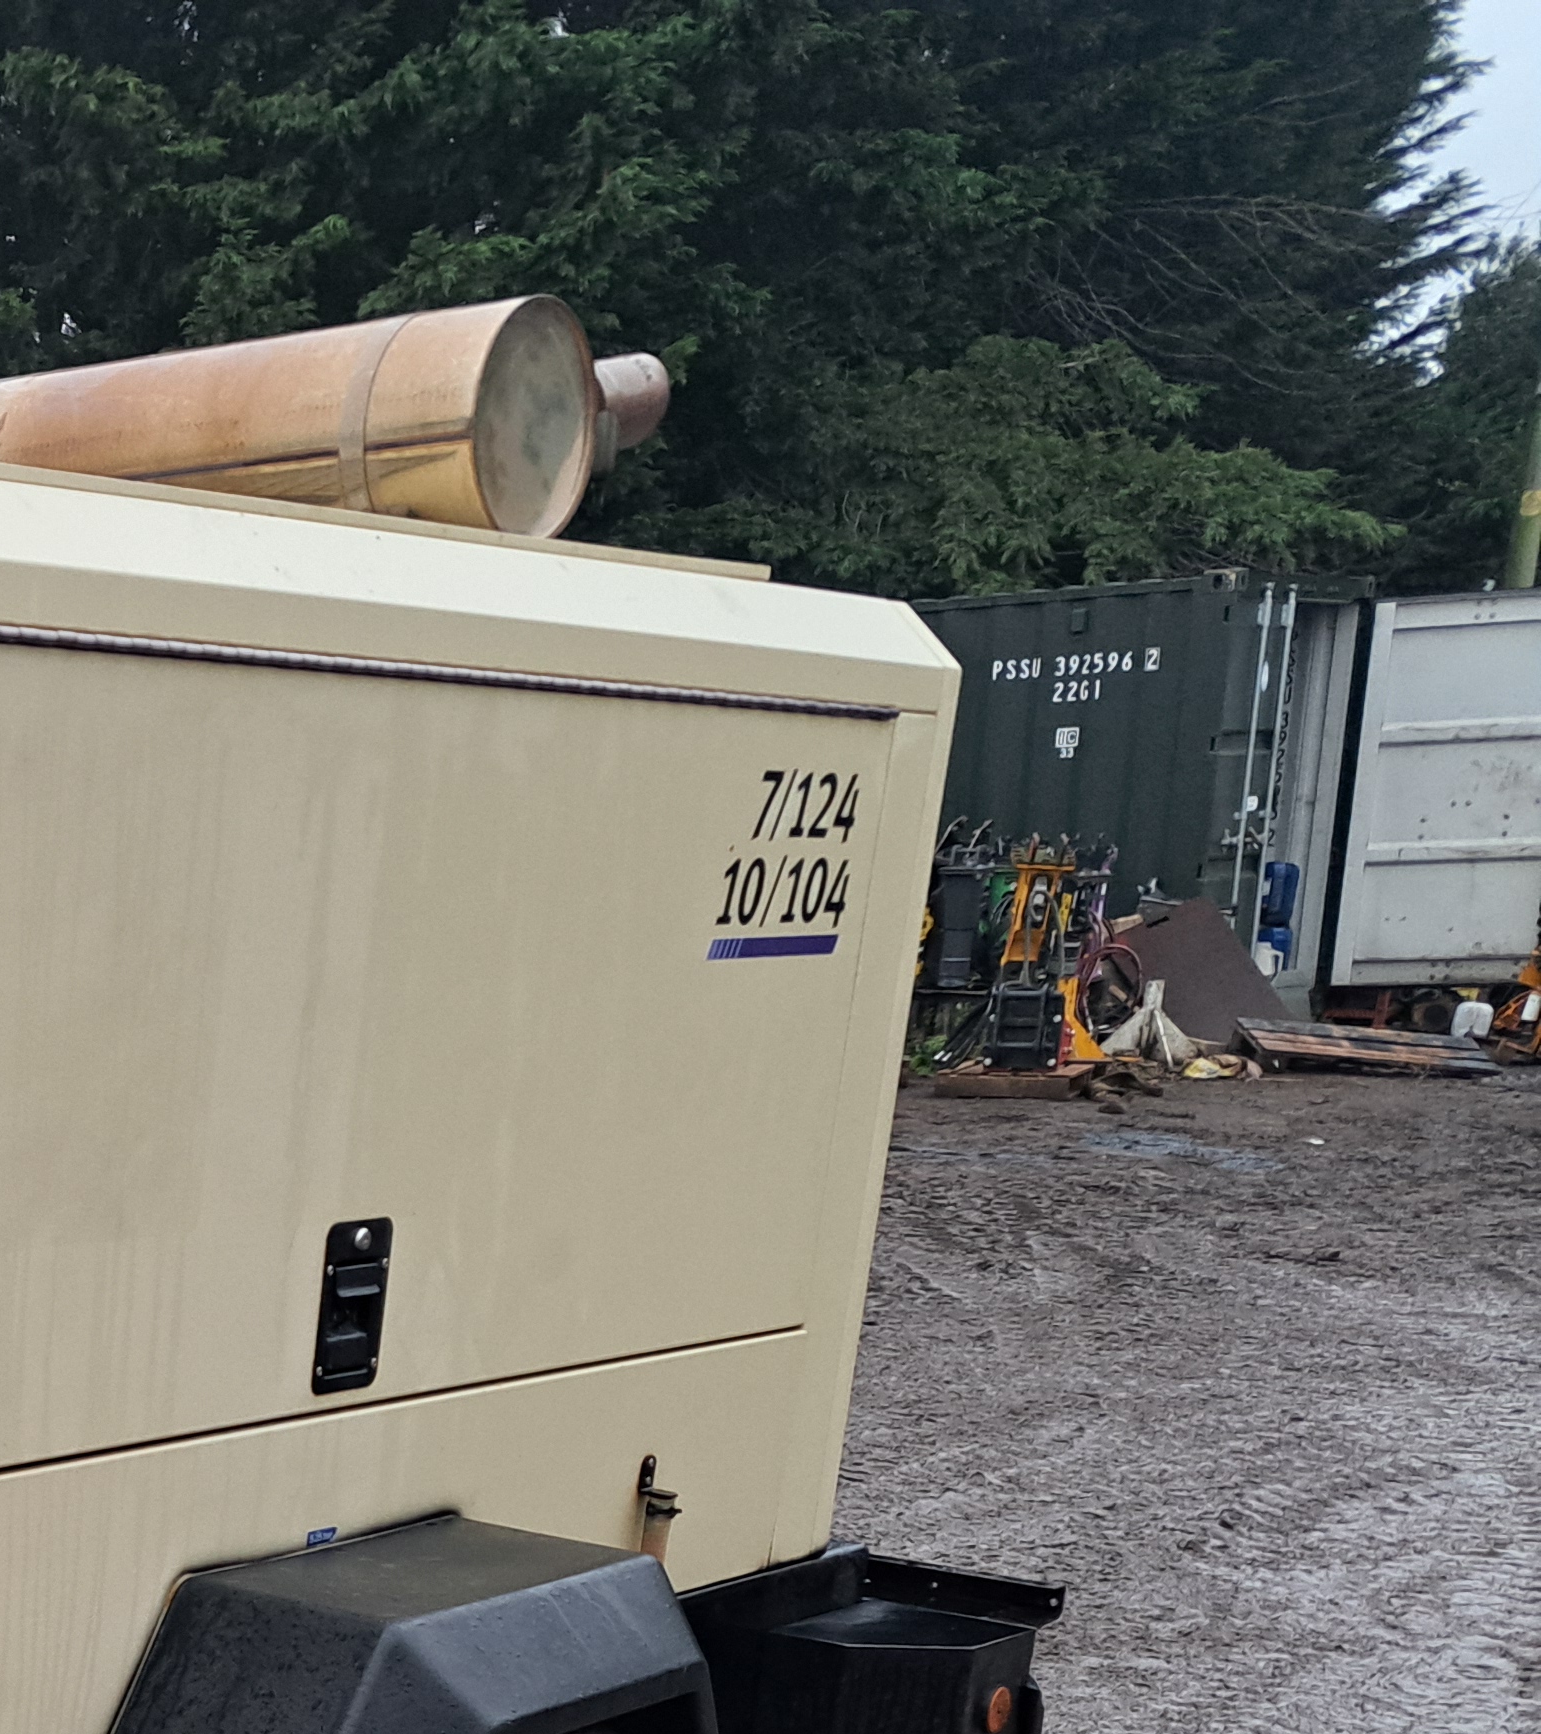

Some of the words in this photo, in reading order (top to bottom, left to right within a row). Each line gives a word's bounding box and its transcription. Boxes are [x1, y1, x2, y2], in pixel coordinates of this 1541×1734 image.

[992, 658, 1041, 681] PSSU
[1054, 651, 1133, 677] 392596
[1146, 648, 1159, 671] 2
[1052, 679, 1101, 702] 22G1
[752, 768, 859, 843] 7/124
[715, 855, 850, 928] 10/104
